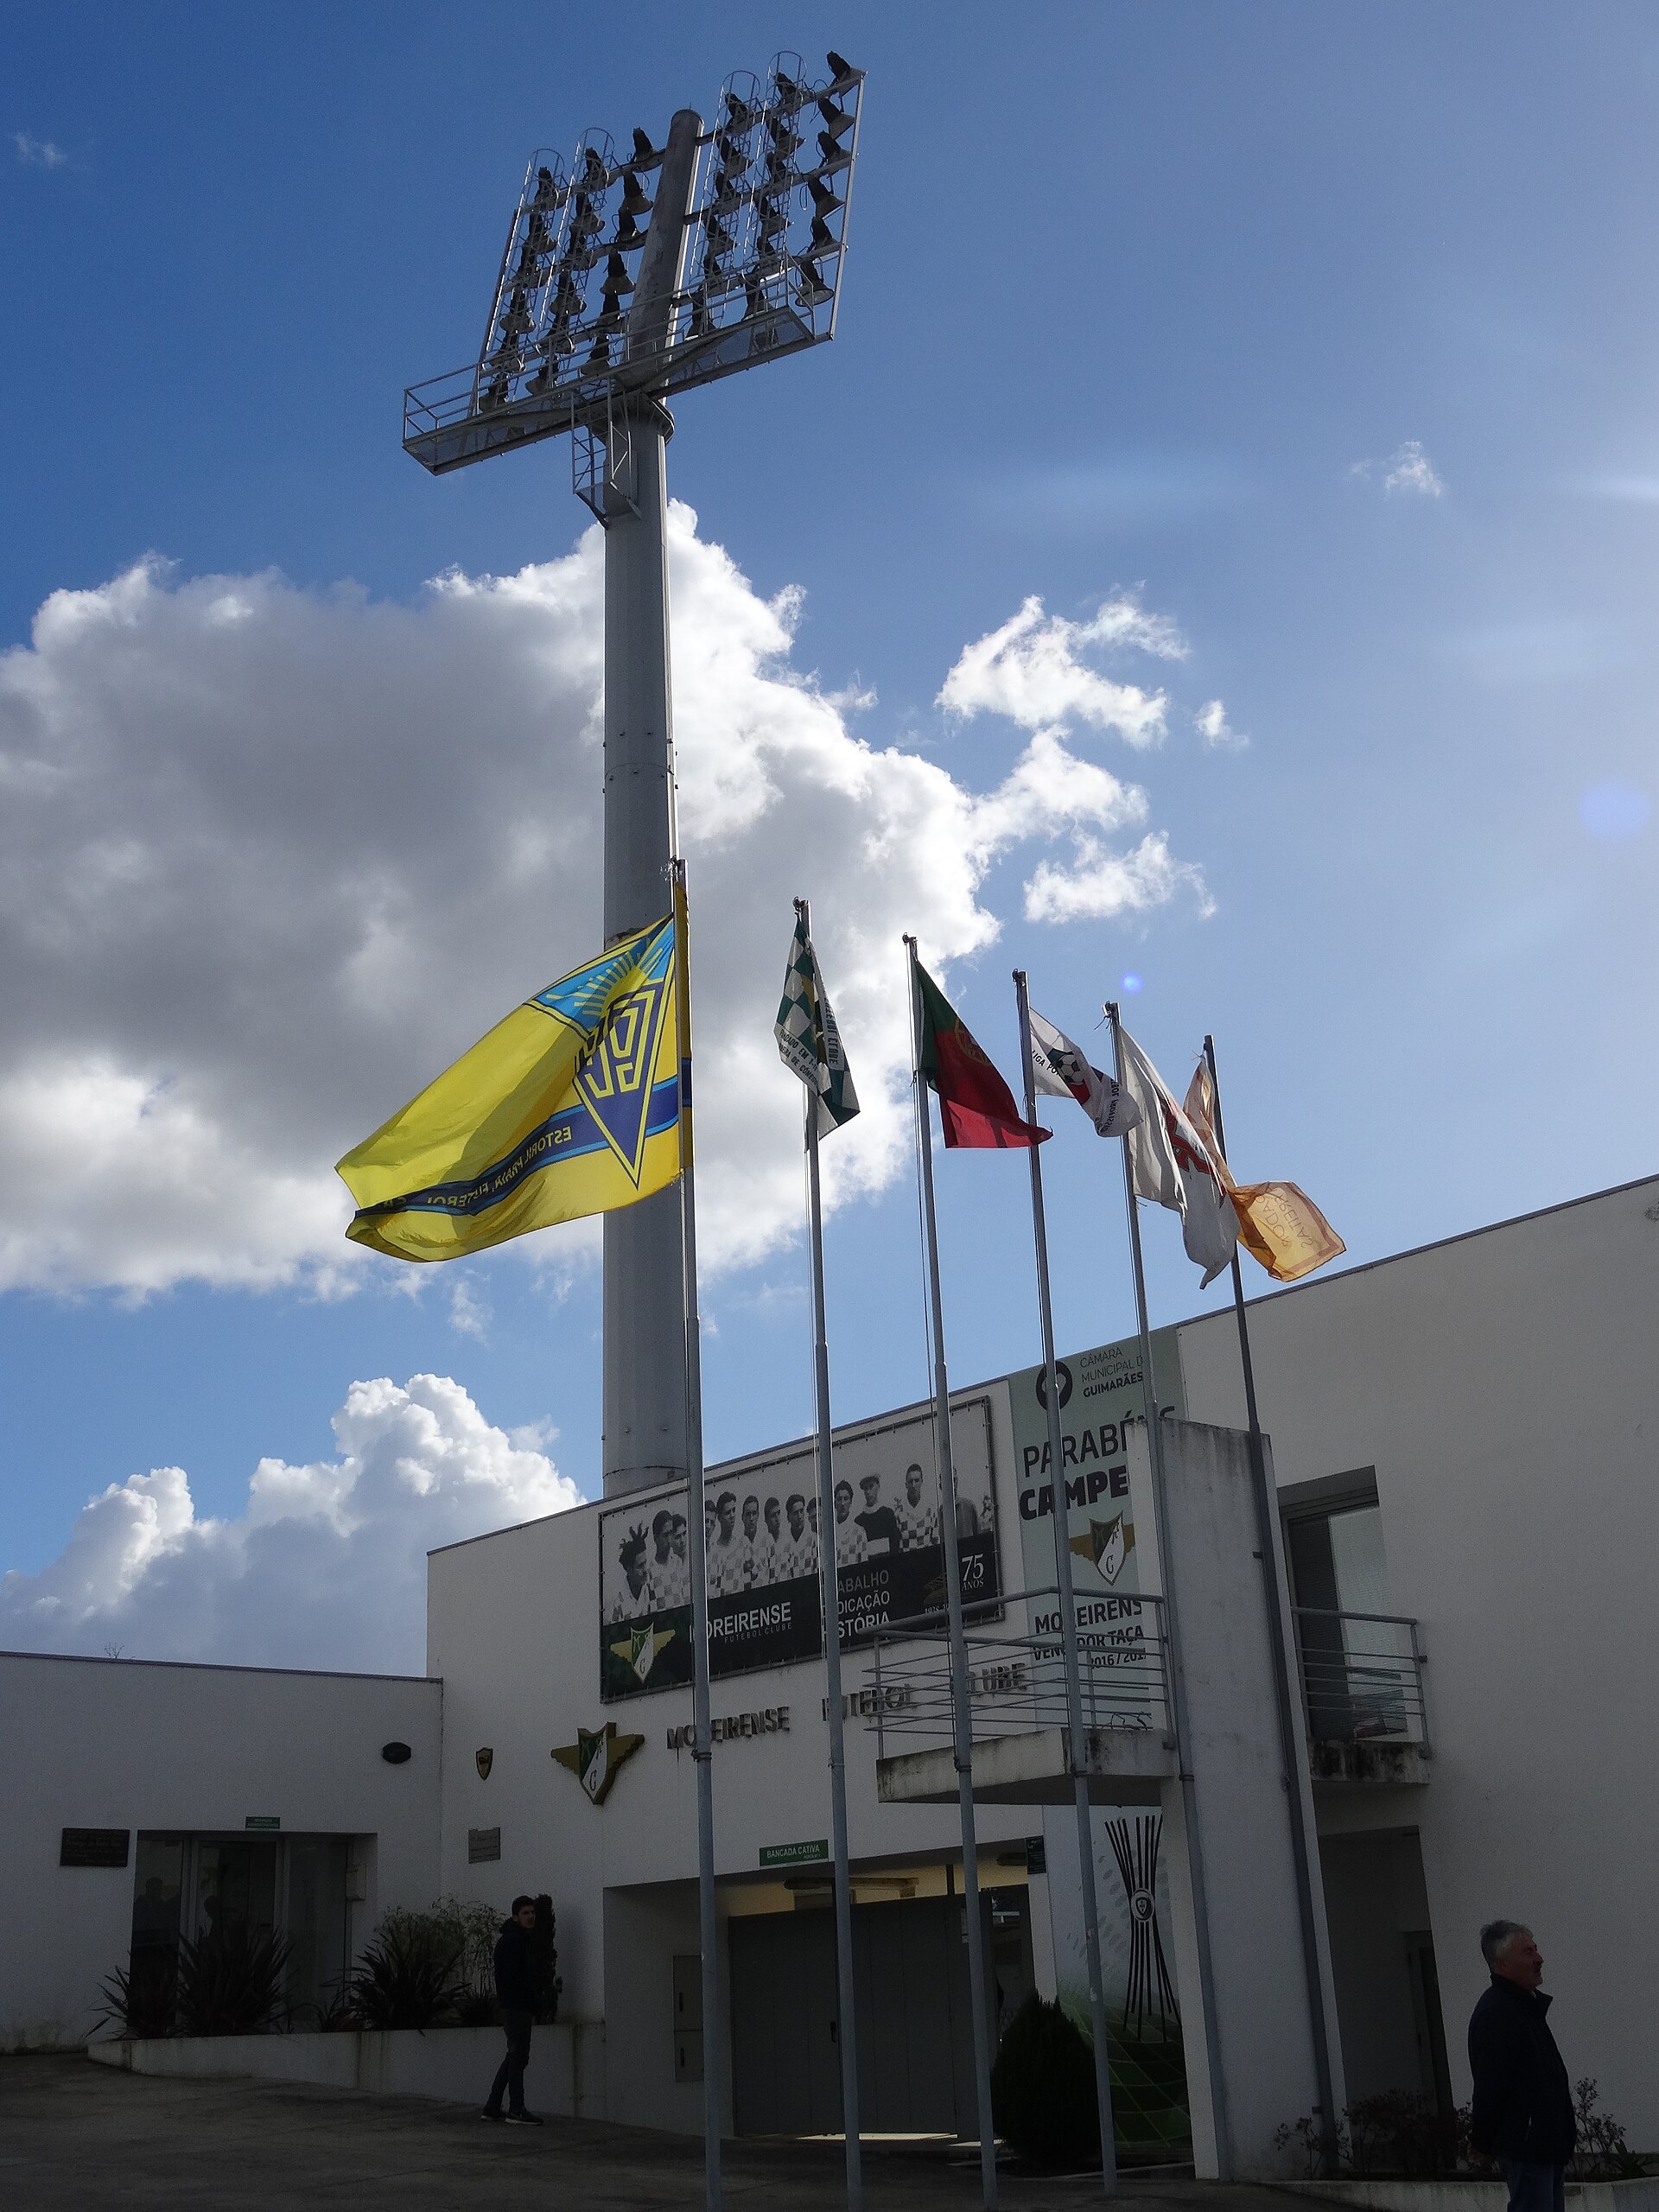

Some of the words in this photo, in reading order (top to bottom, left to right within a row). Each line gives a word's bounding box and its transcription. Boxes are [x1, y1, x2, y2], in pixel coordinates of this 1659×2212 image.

[799, 1064, 818, 1085] CÓNEGO
[1080, 1347, 1123, 1368] CÂMARA
[1081, 1359, 1135, 1383] MUNICIPAL
[1136, 1355, 1144, 1367] D
[1083, 1371, 1143, 1397] GUIMARÃES
[1019, 1465, 1129, 1521] CAMPE
[962, 1553, 984, 1582] 75
[837, 1569, 889, 1593] ABALHO
[961, 1578, 984, 1592] ANOS
[837, 1589, 891, 1615] DICAÇÃO
[838, 1611, 890, 1638] STÓRIA
[1034, 1598, 1142, 1634] MOEIRENS
[724, 1629, 761, 1644] FUTEBOL
[764, 1623, 792, 1635] CLUBE
[1107, 1624, 1144, 1646] TAÇA
[666, 1706, 791, 1750] MOEIRENSE
[766, 1848, 798, 1859] BANCADA
[798, 1844, 820, 1855] CATIVA
